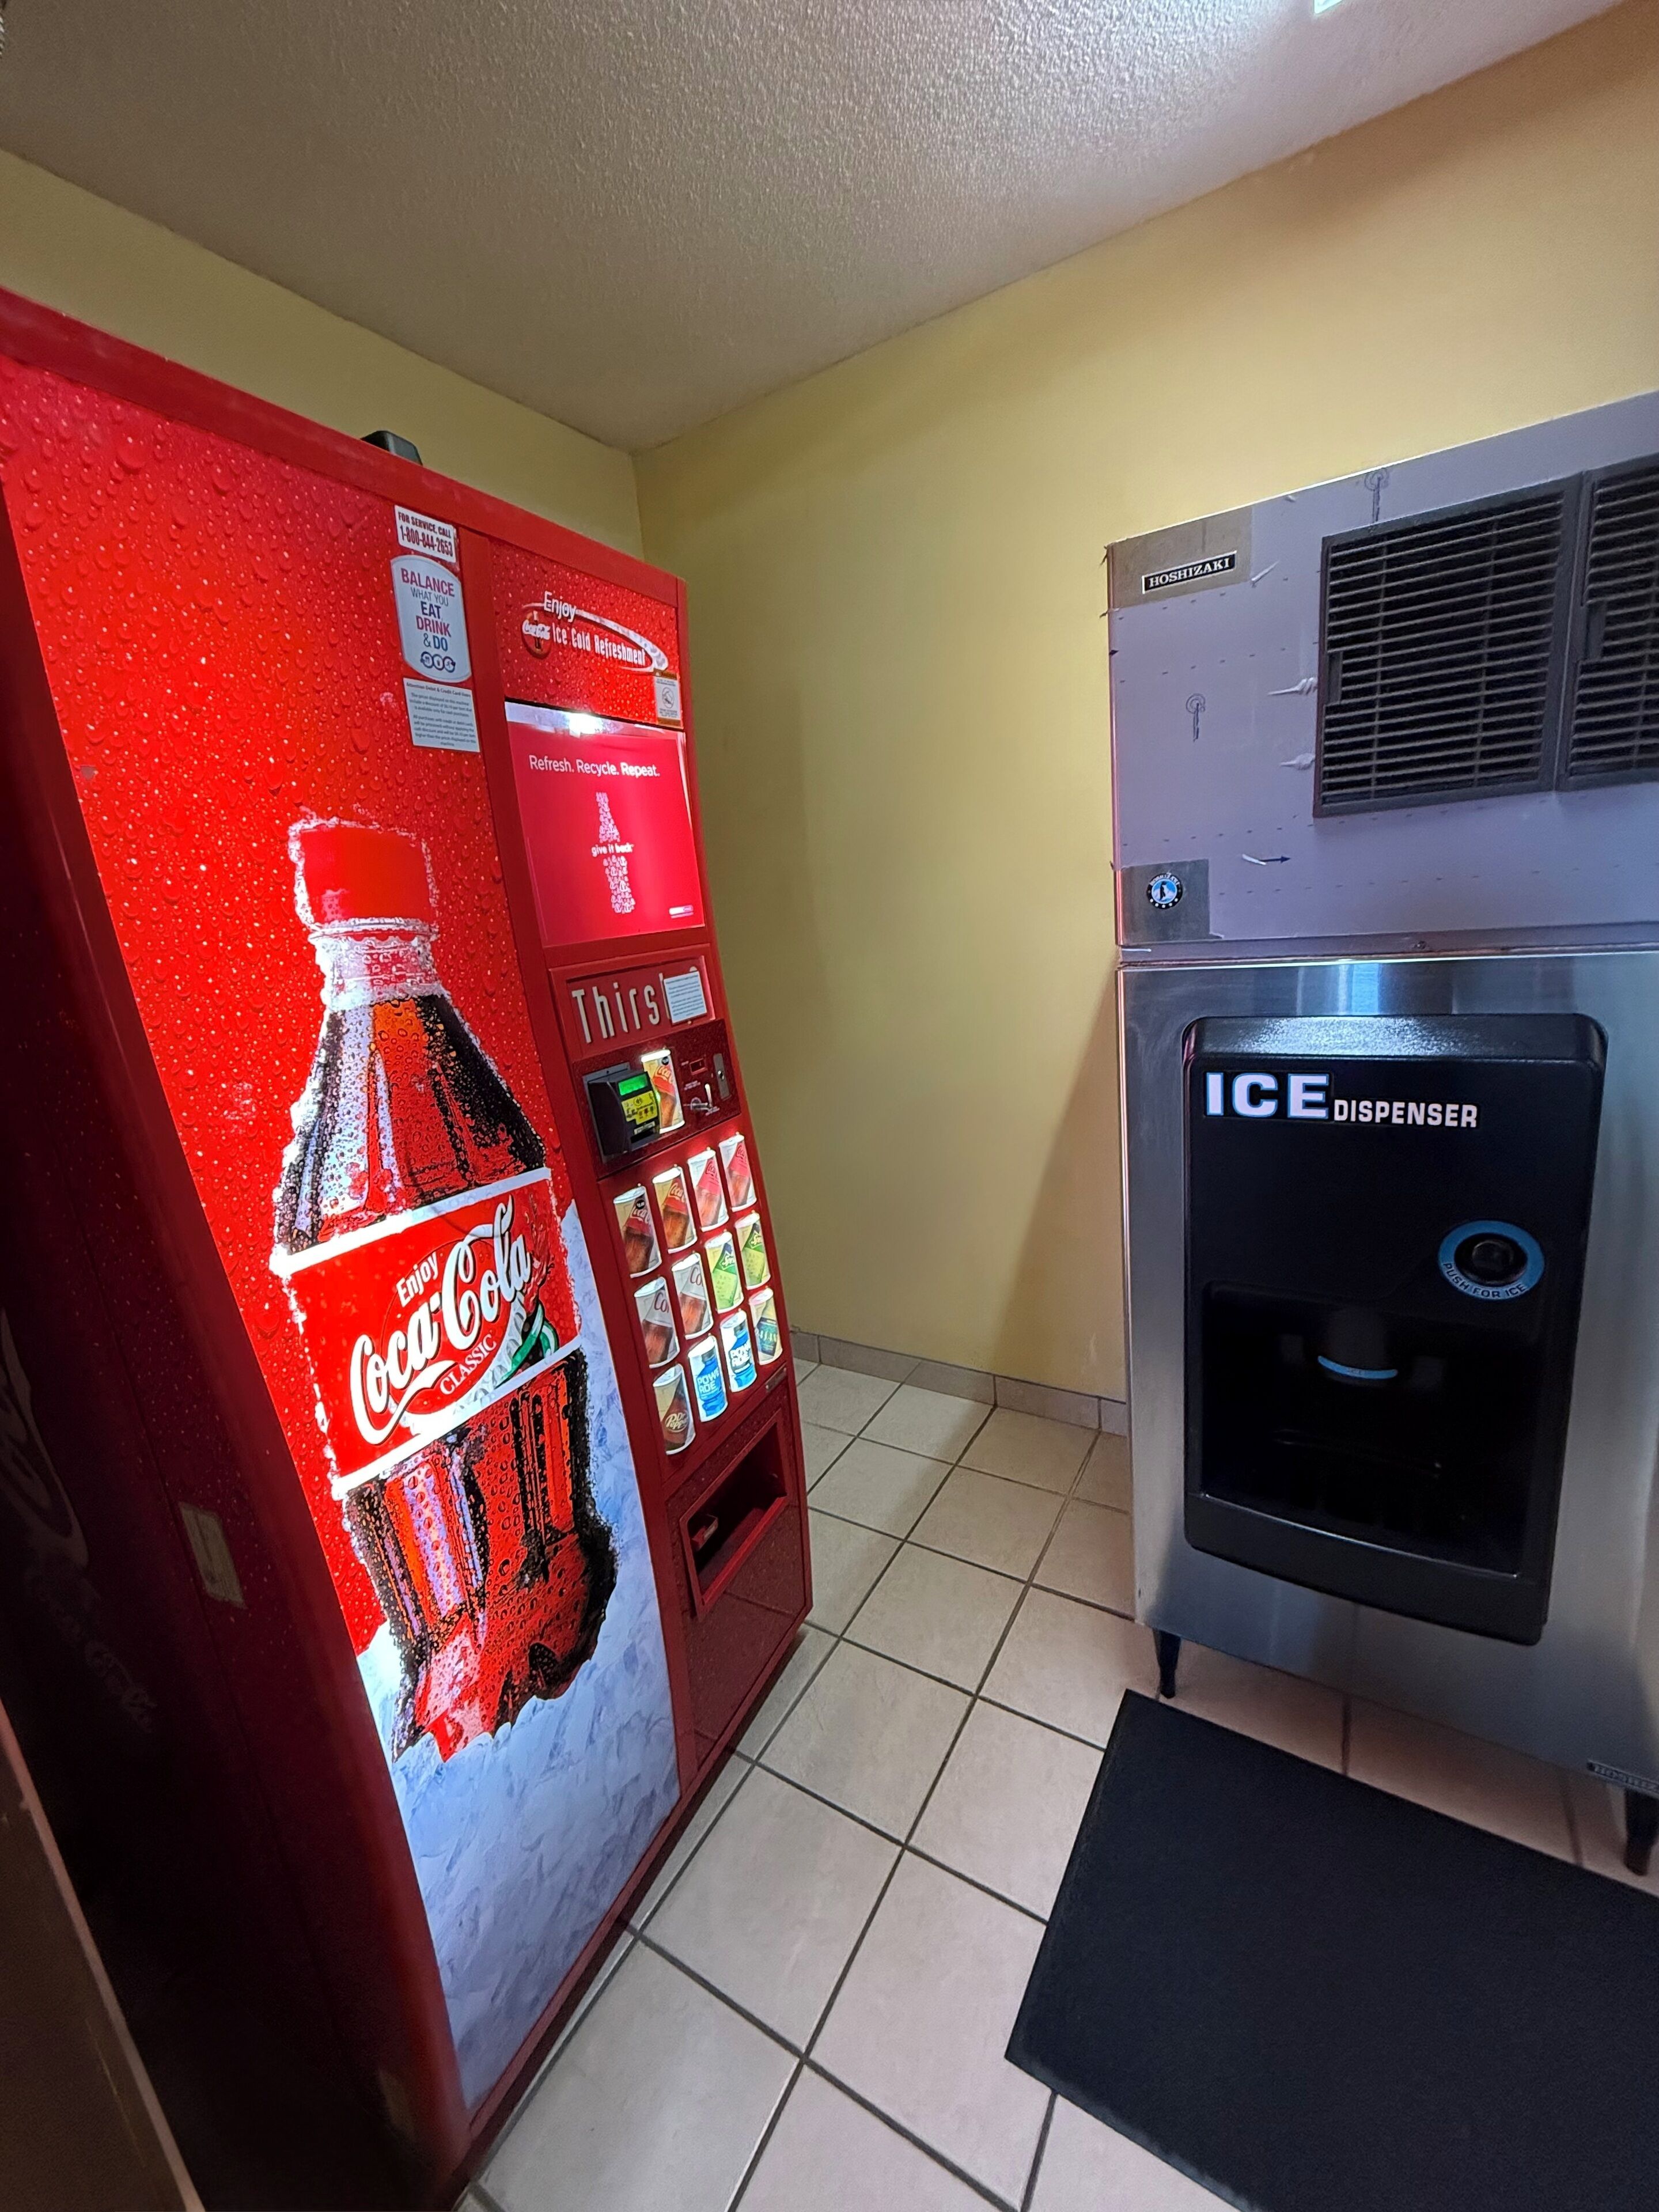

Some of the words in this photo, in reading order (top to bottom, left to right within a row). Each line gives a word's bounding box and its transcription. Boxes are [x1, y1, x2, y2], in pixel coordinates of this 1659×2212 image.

[398, 512, 410, 524] FOR
[411, 516, 437, 534] SERVICE
[438, 527, 451, 539] CALL
[400, 525, 453, 557] 1-800-844-2653
[401, 568, 454, 597] BALANCE
[1149, 558, 1230, 588] HOSHIZAKI
[411, 587, 432, 601] WHAT
[434, 594, 449, 607] YOU
[544, 590, 577, 622] Enjoy
[416, 615, 452, 638] DRINK
[423, 633, 431, 647] &
[433, 635, 448, 652] DO
[552, 622, 567, 645] Ice
[571, 628, 591, 652] Cold
[594, 634, 646, 665] Refreshment
[529, 755, 574, 773] Refresh.
[576, 759, 619, 777] Recycle.
[620, 762, 660, 778] Repeat.
[592, 844, 607, 857] give
[1206, 1072, 1330, 1119] ICE
[1334, 1099, 1478, 1128] DISPENSER
[396, 1251, 440, 1308] Enjoy
[1443, 1263, 1470, 1290] PUSH
[1472, 1287, 1501, 1298] FOR
[1505, 1283, 1527, 1297] ICE
[350, 1194, 531, 1446] Coca-Cola
[439, 1334, 497, 1395] CLASSIC
